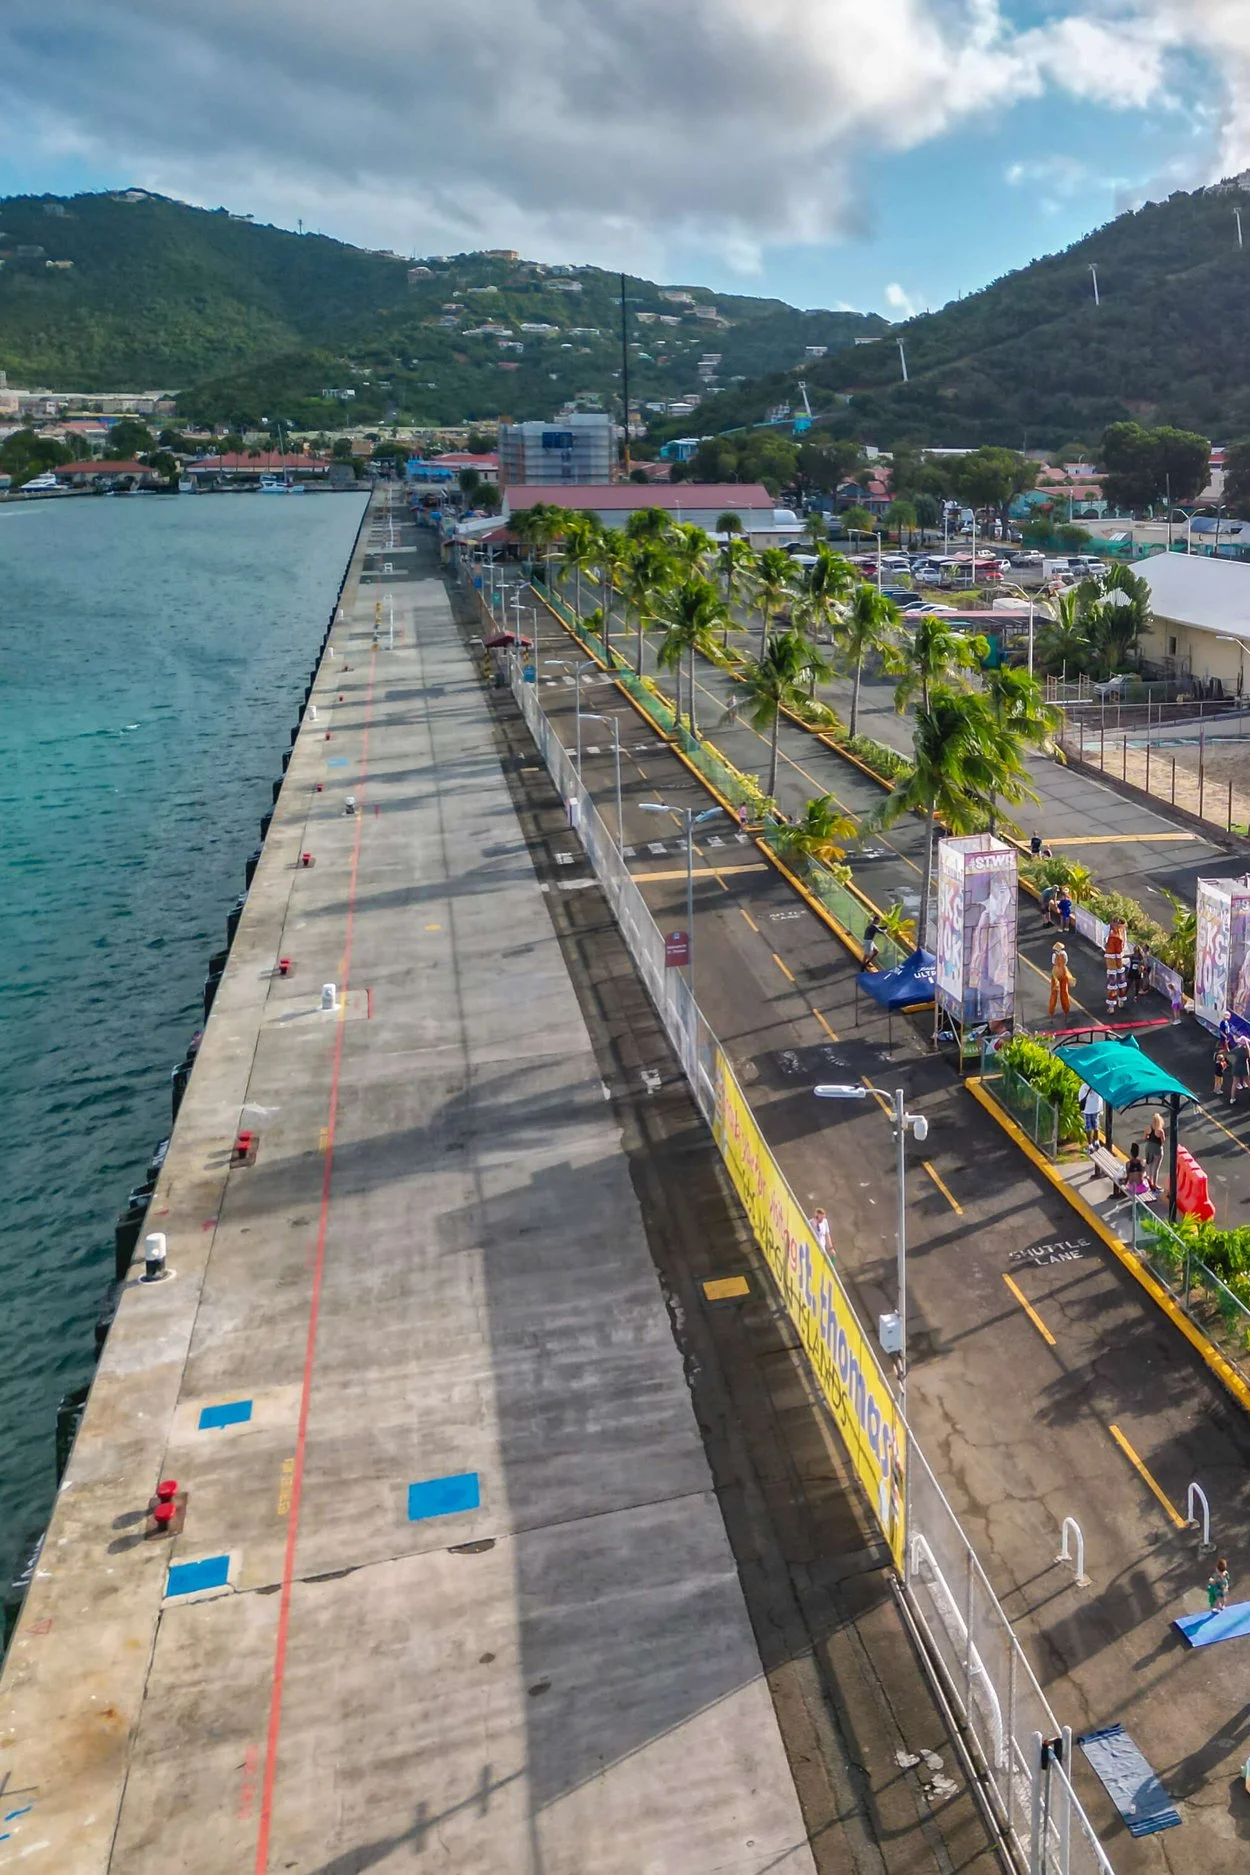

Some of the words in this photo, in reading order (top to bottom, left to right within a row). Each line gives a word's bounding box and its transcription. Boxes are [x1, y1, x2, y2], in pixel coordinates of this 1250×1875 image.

[1008, 1237, 1091, 1260] SHUTTLE
[1035, 1250, 1084, 1265] LANE
[819, 1272, 891, 1480] thomas
